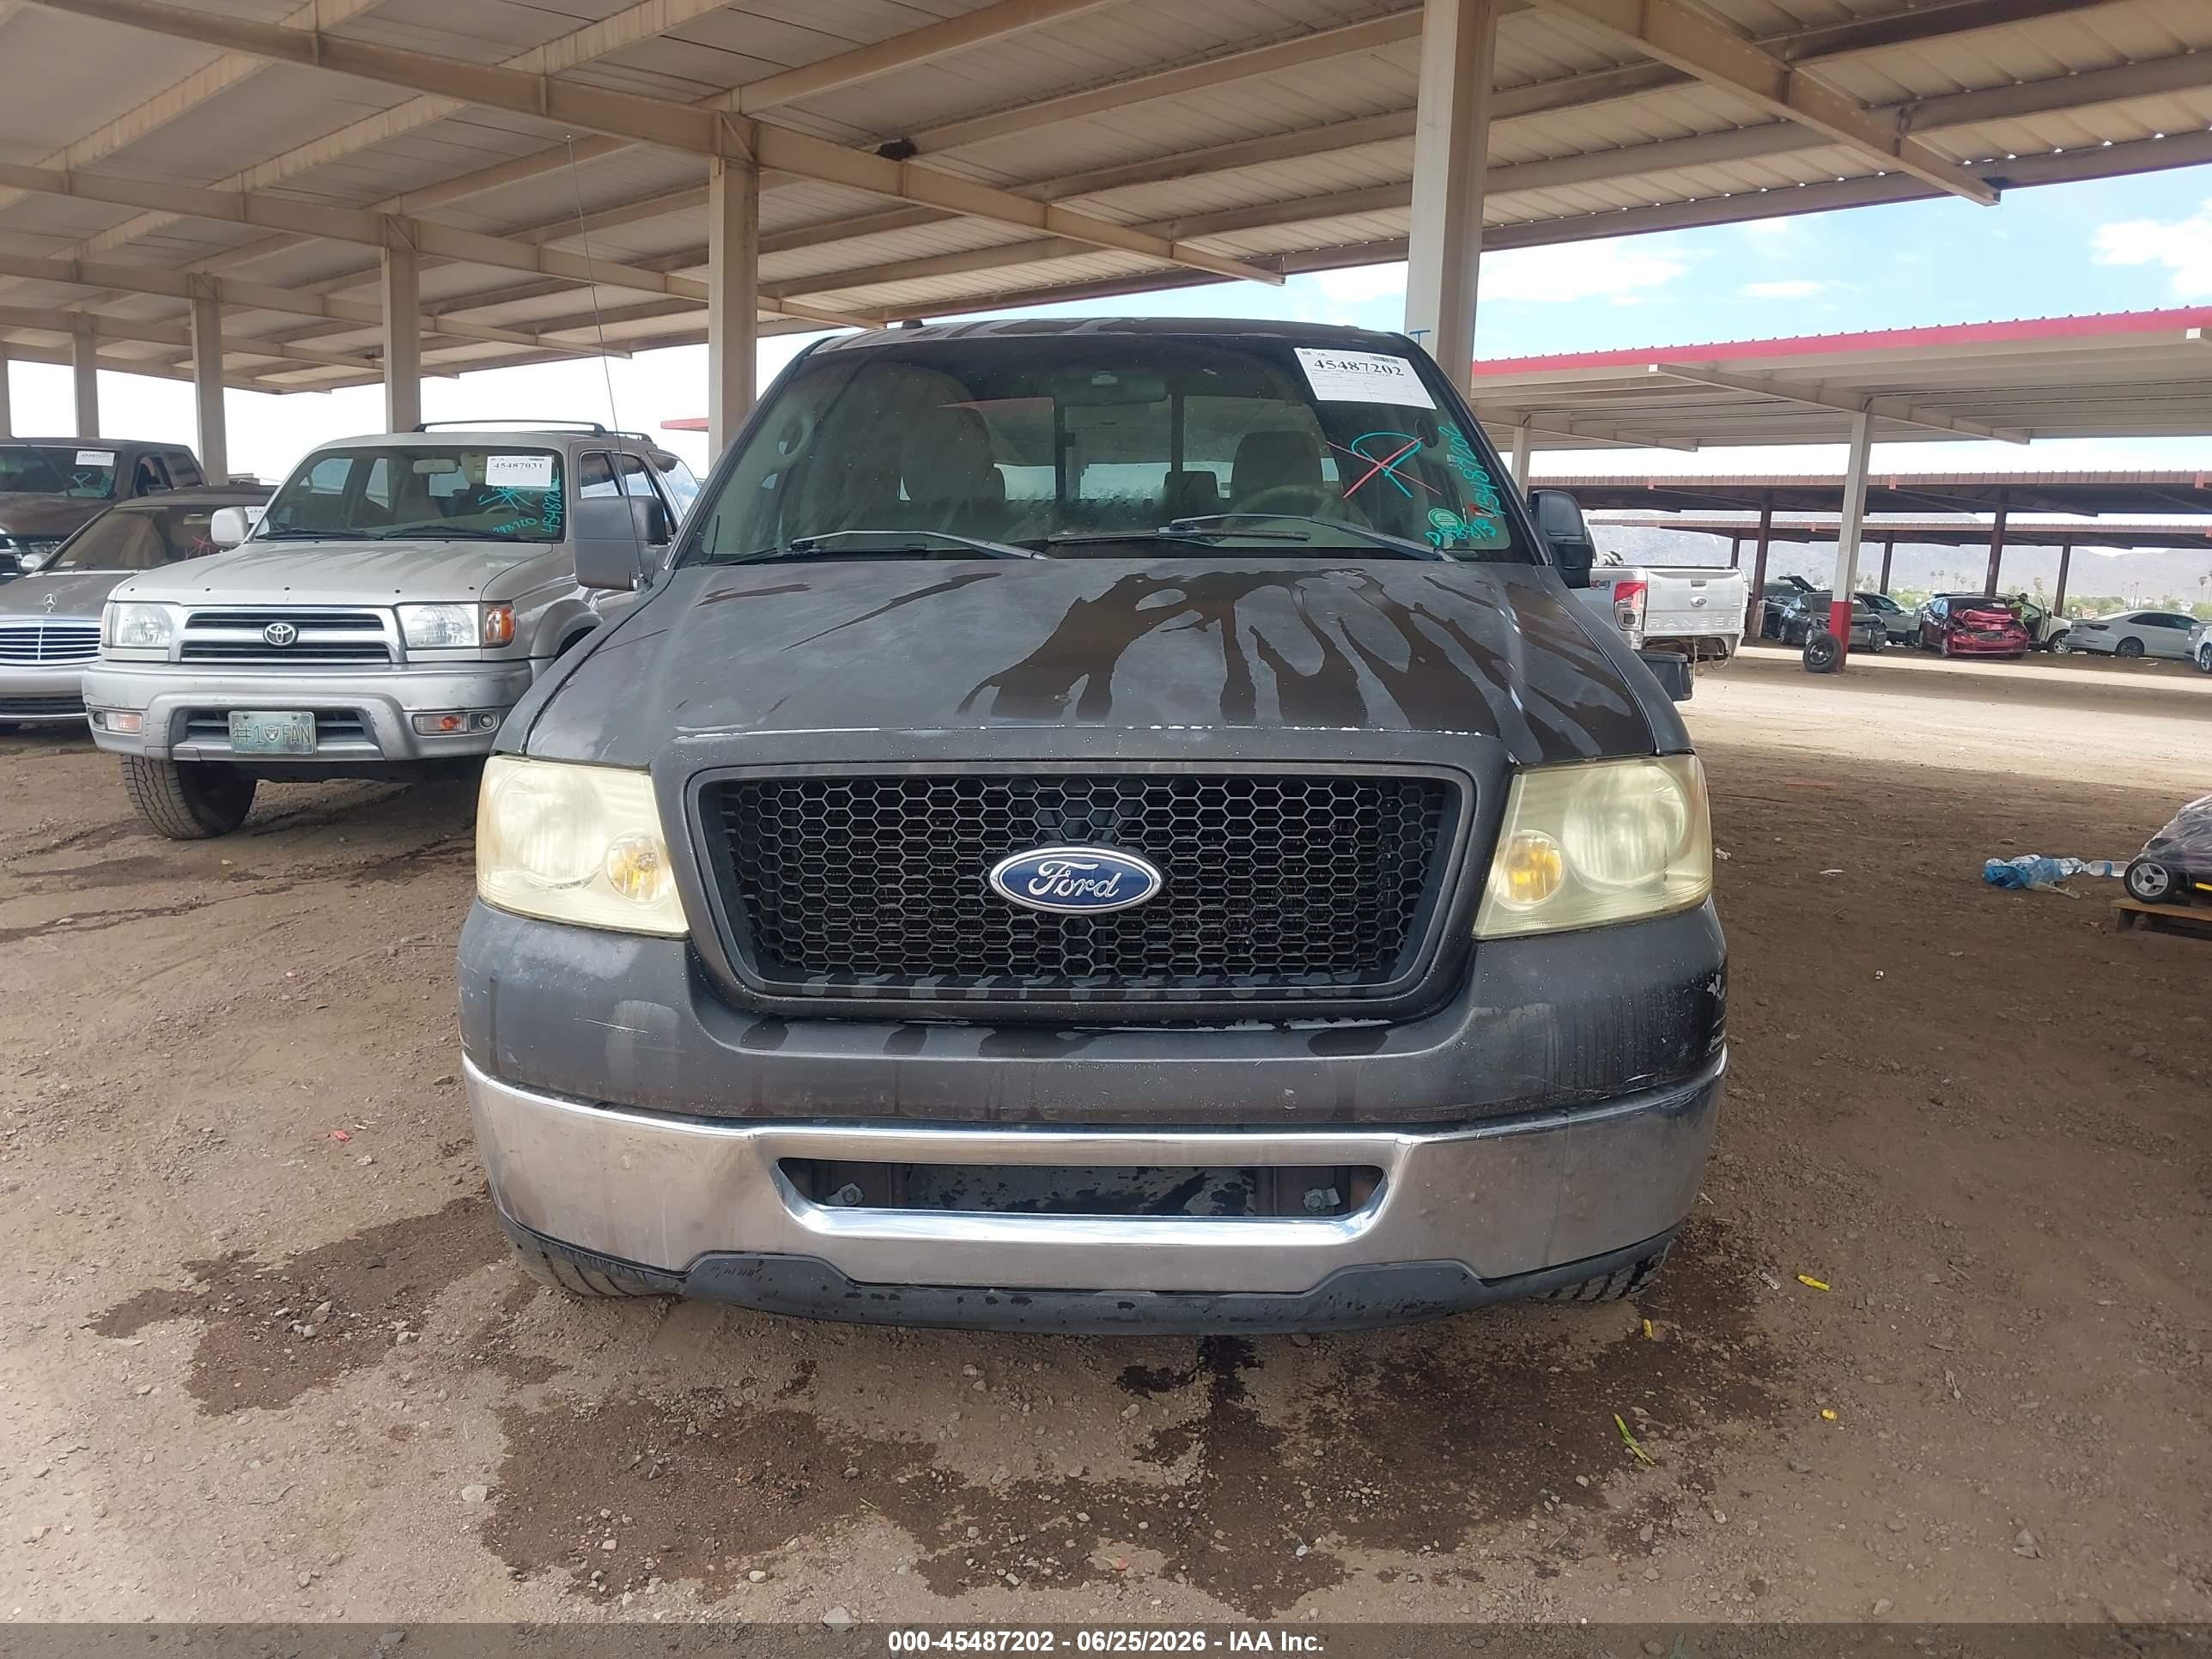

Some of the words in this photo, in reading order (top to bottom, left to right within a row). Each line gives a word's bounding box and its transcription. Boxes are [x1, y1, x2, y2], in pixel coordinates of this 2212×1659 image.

[1314, 359, 1404, 376] 45487202
[1648, 616, 1739, 629] RANGER
[233, 723, 264, 744] #1
[282, 723, 312, 744] FAN
[1028, 860, 1122, 898] Ford
